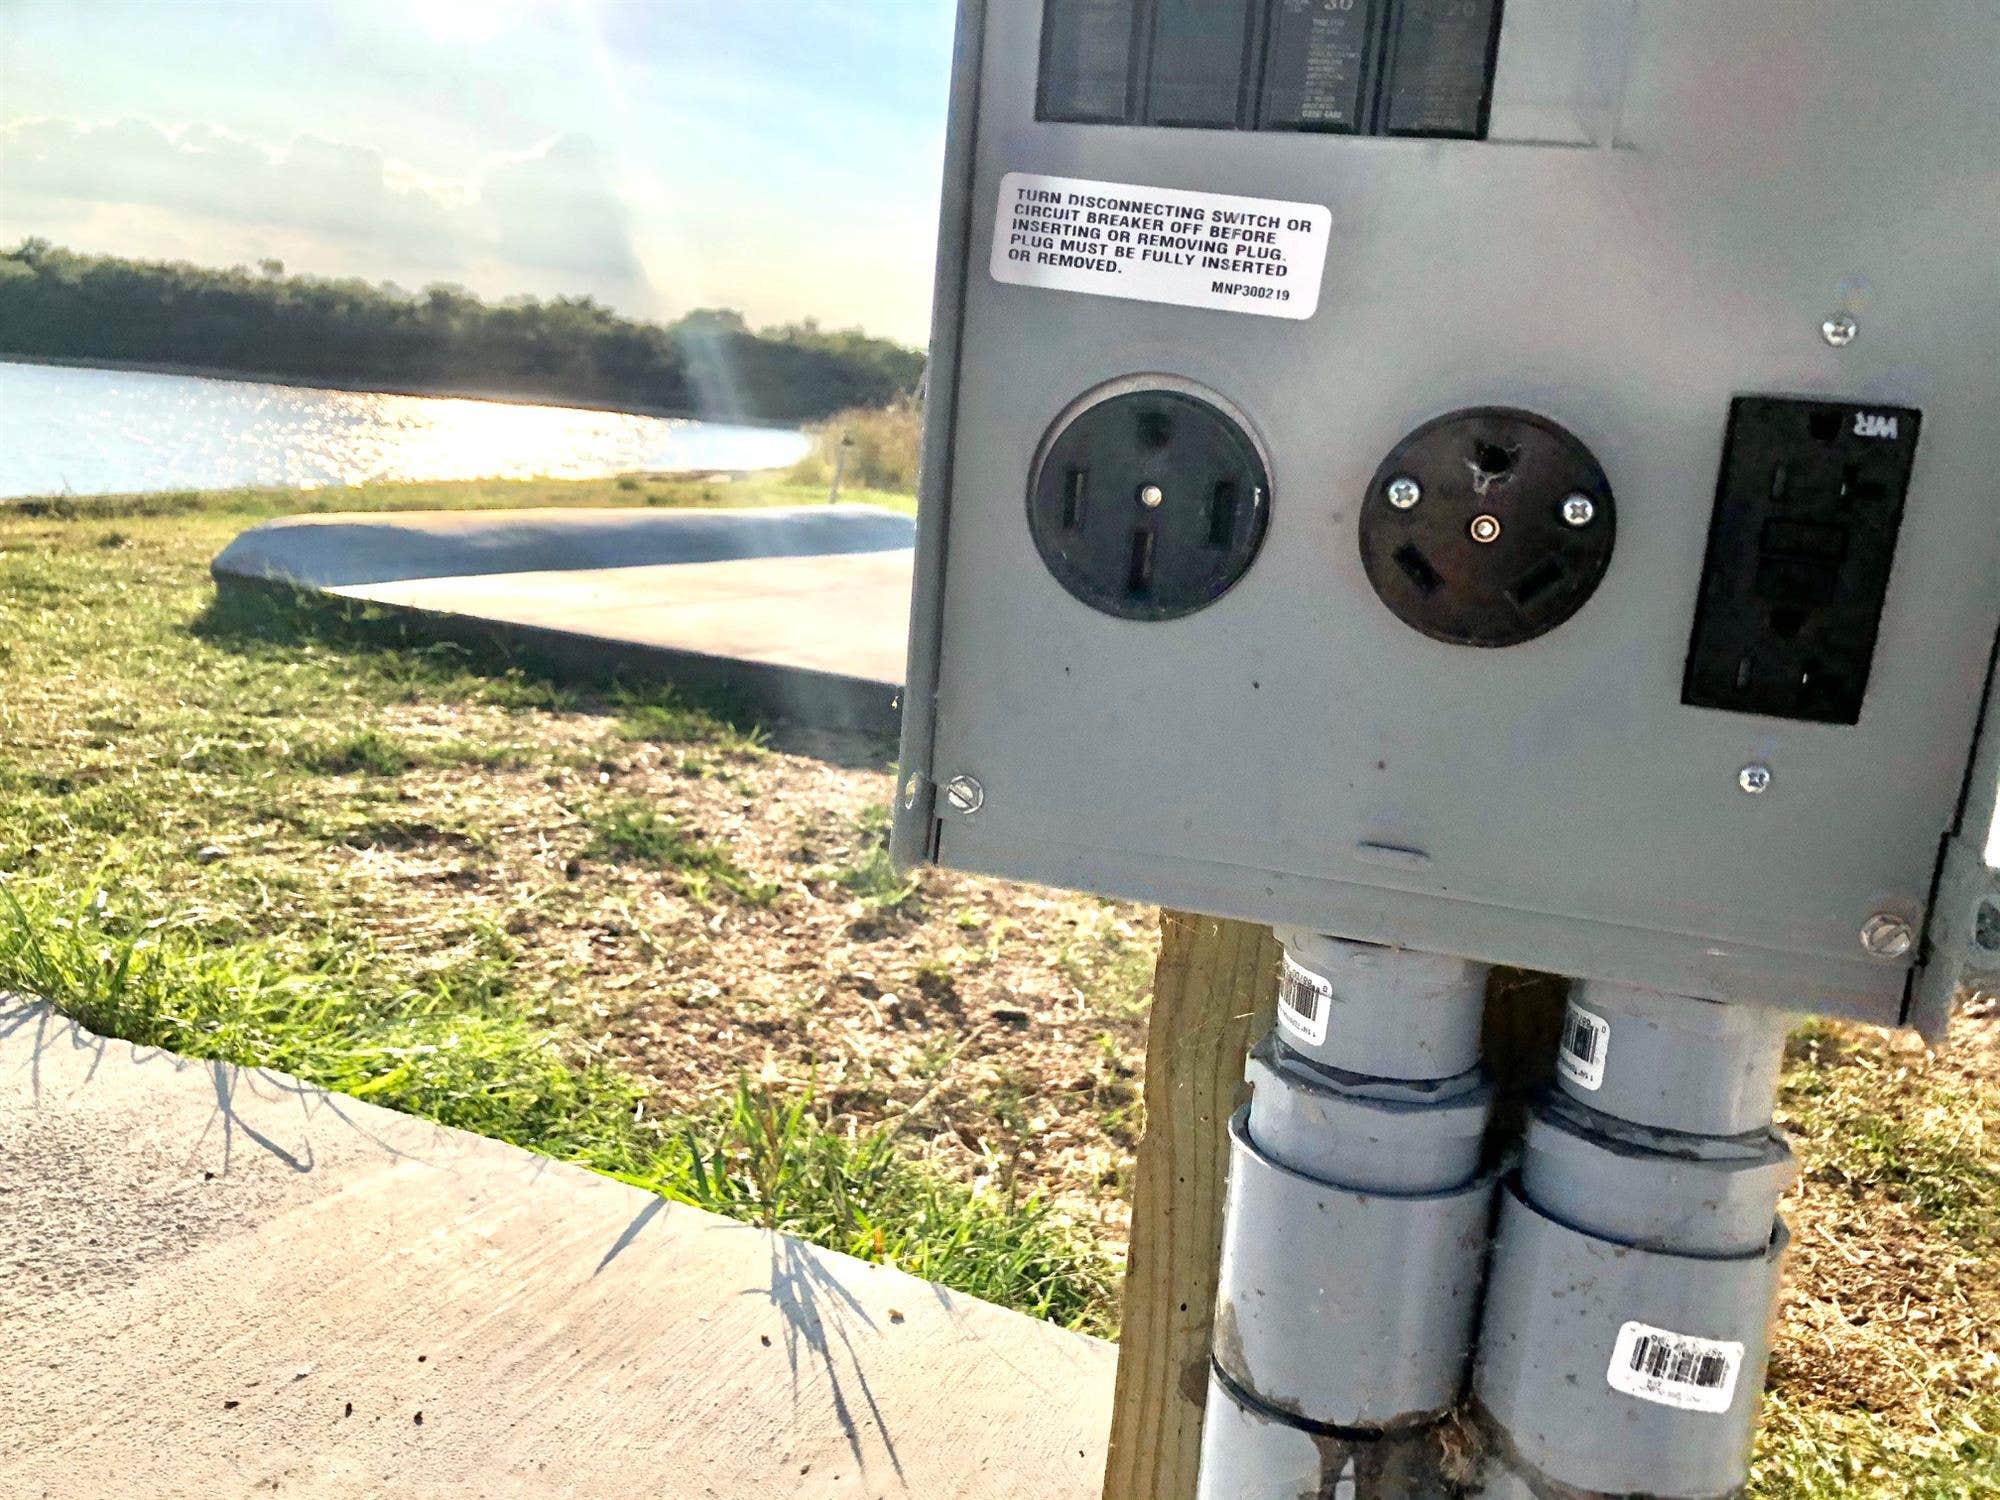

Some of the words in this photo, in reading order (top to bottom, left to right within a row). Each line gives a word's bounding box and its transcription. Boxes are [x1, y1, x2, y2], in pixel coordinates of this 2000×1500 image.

[1014, 202, 1081, 222] CIRCUIT
[1086, 211, 1164, 232] BREAKER
[1170, 221, 1203, 236] OFF
[1209, 225, 1277, 245] BEFORE
[1016, 187, 1062, 205] TURN
[1068, 193, 1205, 221] DISCONNECTING
[1211, 210, 1281, 229] SWITCH
[1286, 219, 1312, 233] OR
[1007, 248, 1031, 262] OR
[1036, 251, 1122, 274] REMOVED.
[1010, 232, 1054, 250] PLUG
[1060, 239, 1109, 256] MUST
[1114, 245, 1136, 259] BE
[1141, 249, 1196, 266] FULLY
[1201, 256, 1288, 277] INSERTED
[1011, 217, 1101, 240] INSERTING
[1107, 229, 1131, 243] OR
[1137, 232, 1229, 255] REMOVING
[1235, 243, 1287, 262] PLUG.
[1211, 281, 1290, 301] MNP300219
[1853, 411, 1899, 439] WR
